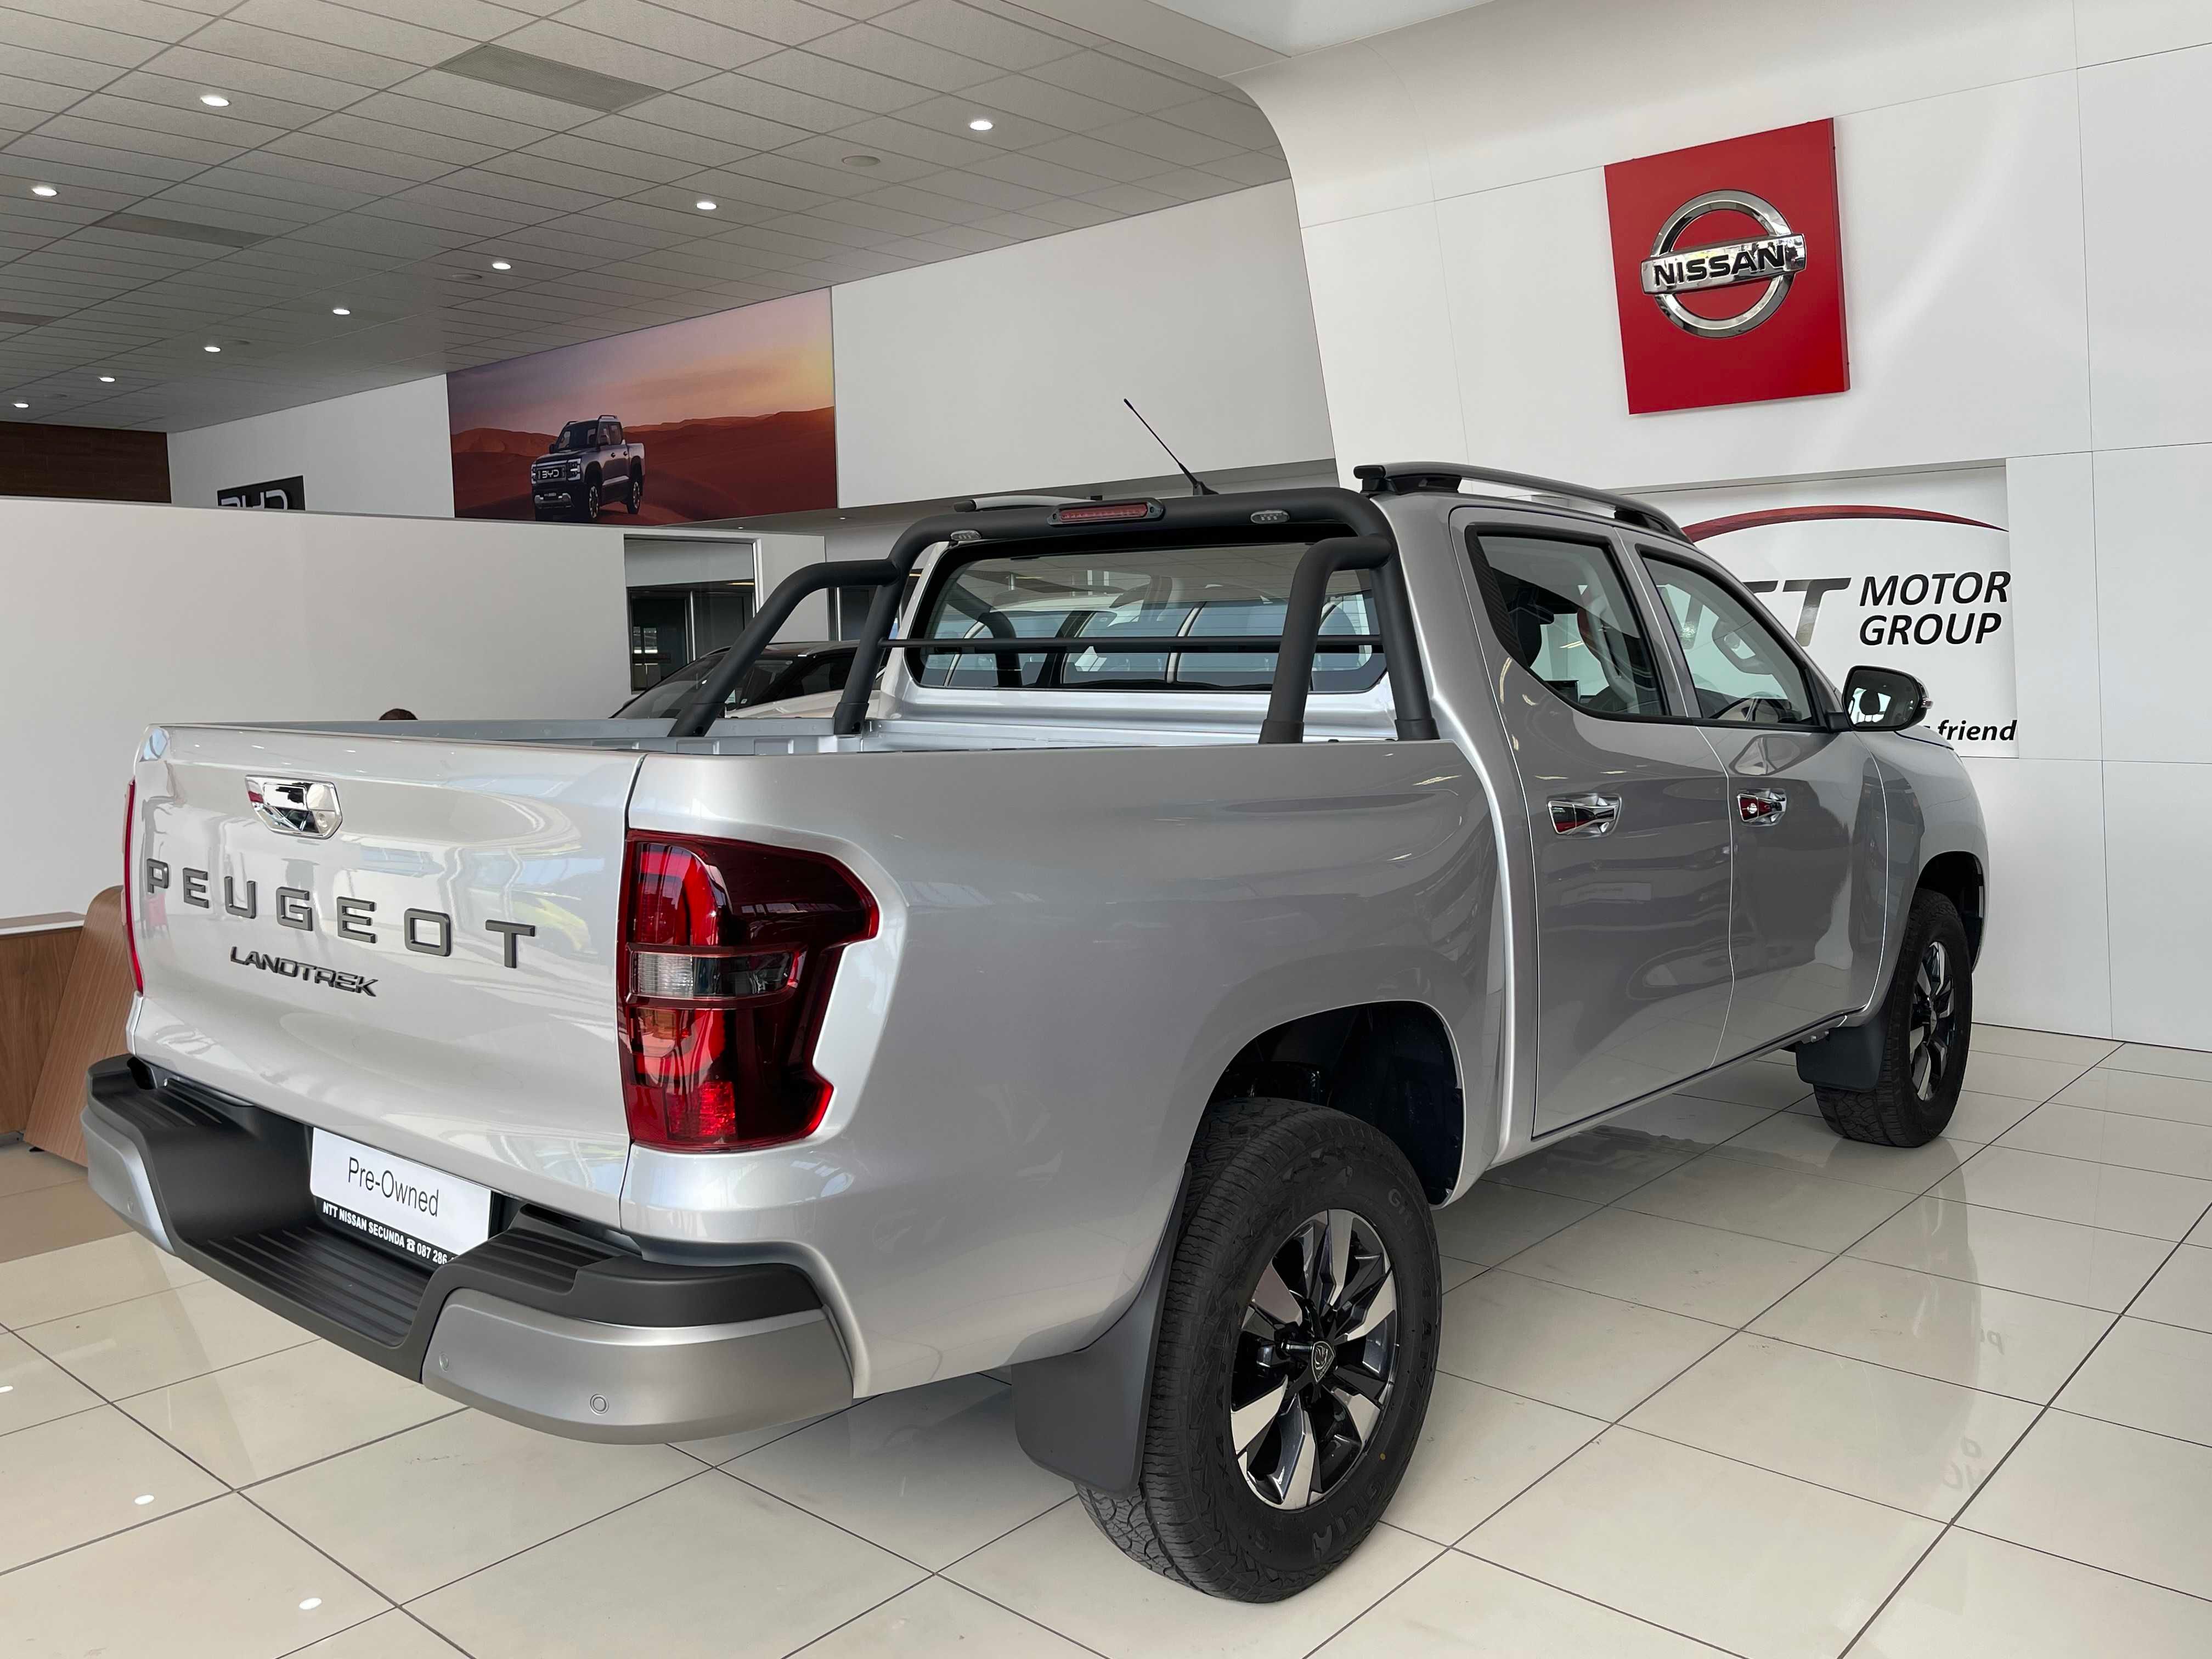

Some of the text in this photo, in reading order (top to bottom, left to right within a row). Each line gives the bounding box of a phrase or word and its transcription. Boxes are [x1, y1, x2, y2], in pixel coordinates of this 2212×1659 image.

[1653, 245, 1785, 286] NISSAN
[541, 469, 560, 479] BYD
[1859, 571, 2012, 607] MOTOR
[1859, 612, 2002, 646] GROUP
[1937, 719, 2018, 741] friend
[146, 858, 536, 969] PEUGEOT
[230, 946, 379, 997] LANDTREK
[348, 1156, 439, 1218] Pre-Owned
[323, 1201, 448, 1265] NTT NISSAN SECUNDA 087 286
